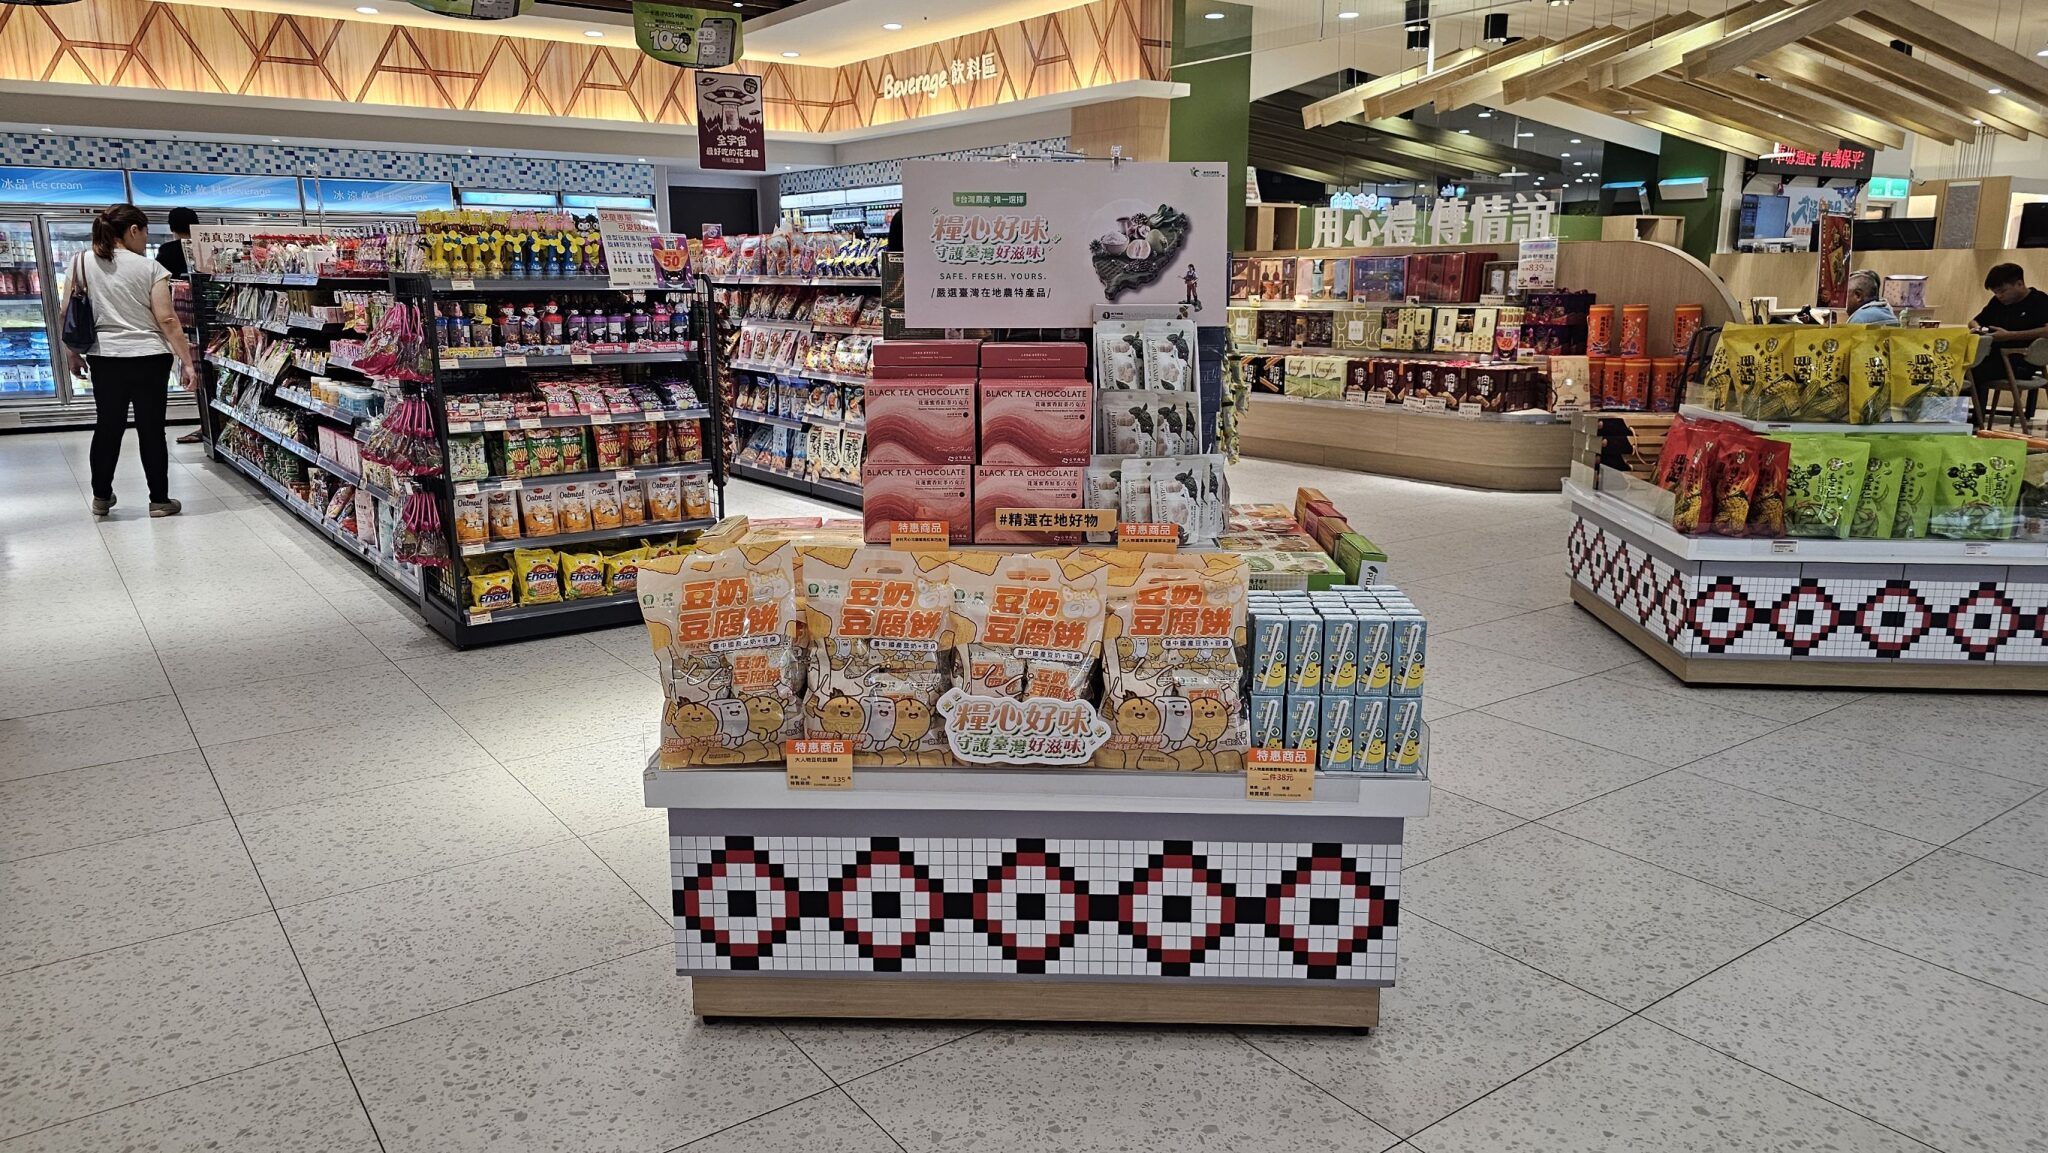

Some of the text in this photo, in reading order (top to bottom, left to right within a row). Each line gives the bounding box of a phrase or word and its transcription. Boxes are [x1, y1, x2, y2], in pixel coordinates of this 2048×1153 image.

[650, 29, 688, 53] 10%
[883, 52, 998, 100] Beverage 飲料區
[716, 134, 747, 147] 全宇宙
[706, 147, 759, 158] 最好吃的花生糖
[1, 178, 83, 191] 冰品 Ice cream
[1311, 192, 1556, 248] 用心禮 傳情誼
[932, 215, 1047, 241] 糧心好味
[200, 232, 245, 243] 清真認證
[936, 244, 1042, 261] 守護臺灣好滋味
[663, 255, 680, 267] 50
[939, 272, 1047, 280] SAFE. FRESH. YOURS.
[1823, 355, 1835, 381] 烤玉米
[917, 388, 969, 396] CHOCOLATE
[986, 390, 1087, 398] BLACK TEA CHOCOLATE
[979, 469, 1078, 477] BLACK TEA CHOCOLATE
[526, 492, 552, 502] Oatmeal
[560, 490, 585, 499] Oatmeal
[458, 499, 482, 508] Oatmeal
[999, 513, 1098, 527] #精選在地好物
[898, 522, 942, 533] 特惠商品
[1125, 525, 1171, 535] 特惠商品
[681, 578, 749, 611] 豆奶
[846, 580, 914, 607] 豆奶
[1136, 585, 1203, 606] 豆奶
[992, 587, 1060, 616] 豆奶
[678, 603, 778, 642] 豆腐餅
[838, 608, 942, 638] 豆腐餅
[1130, 608, 1231, 636] 豆腐餅
[983, 616, 1087, 648] 豆腐餅
[735, 656, 768, 669] 豆奶
[734, 668, 780, 684] 豆腐餅
[1035, 669, 1068, 684] 豆奶
[953, 702, 1090, 735] 糧心好味
[795, 742, 844, 753] 特惠商品
[957, 735, 1083, 754] 守護臺灣好滋味
[1257, 750, 1307, 762] 特惠商品
[1262, 773, 1294, 781] 二件38元
